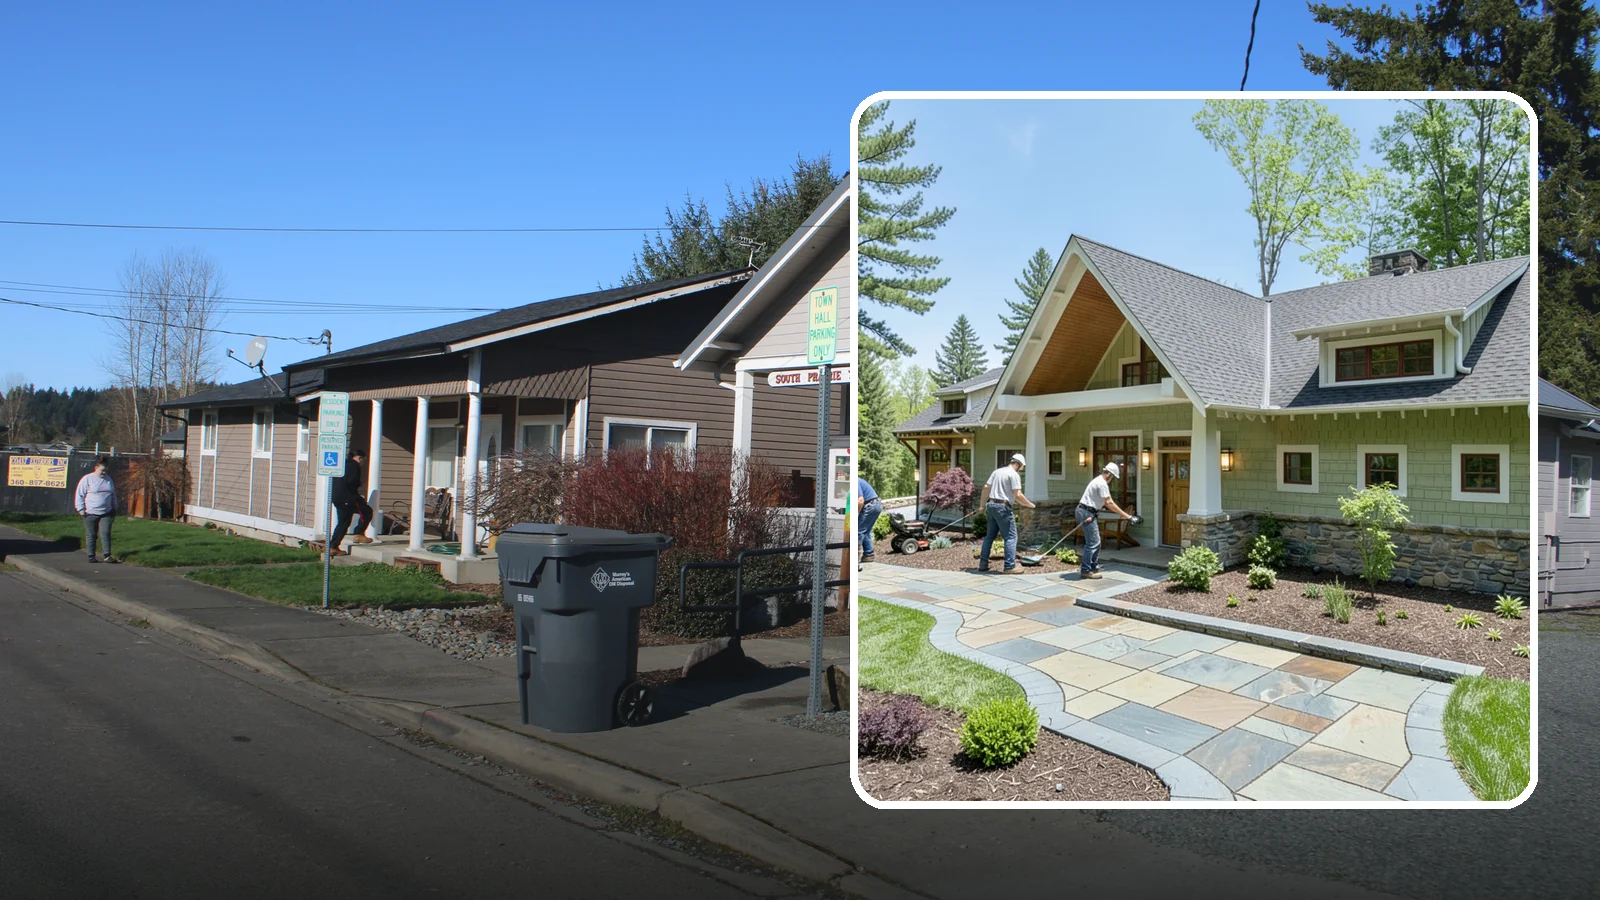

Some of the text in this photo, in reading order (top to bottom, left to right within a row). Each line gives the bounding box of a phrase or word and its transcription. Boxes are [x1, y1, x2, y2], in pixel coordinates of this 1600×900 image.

[815, 295, 832, 307] TOWN
[814, 311, 831, 324] HALL
[810, 326, 835, 341] PARKING
[813, 344, 830, 357] ONLY
[775, 373, 801, 384] SOUTH
[807, 370, 842, 382] PRIE
